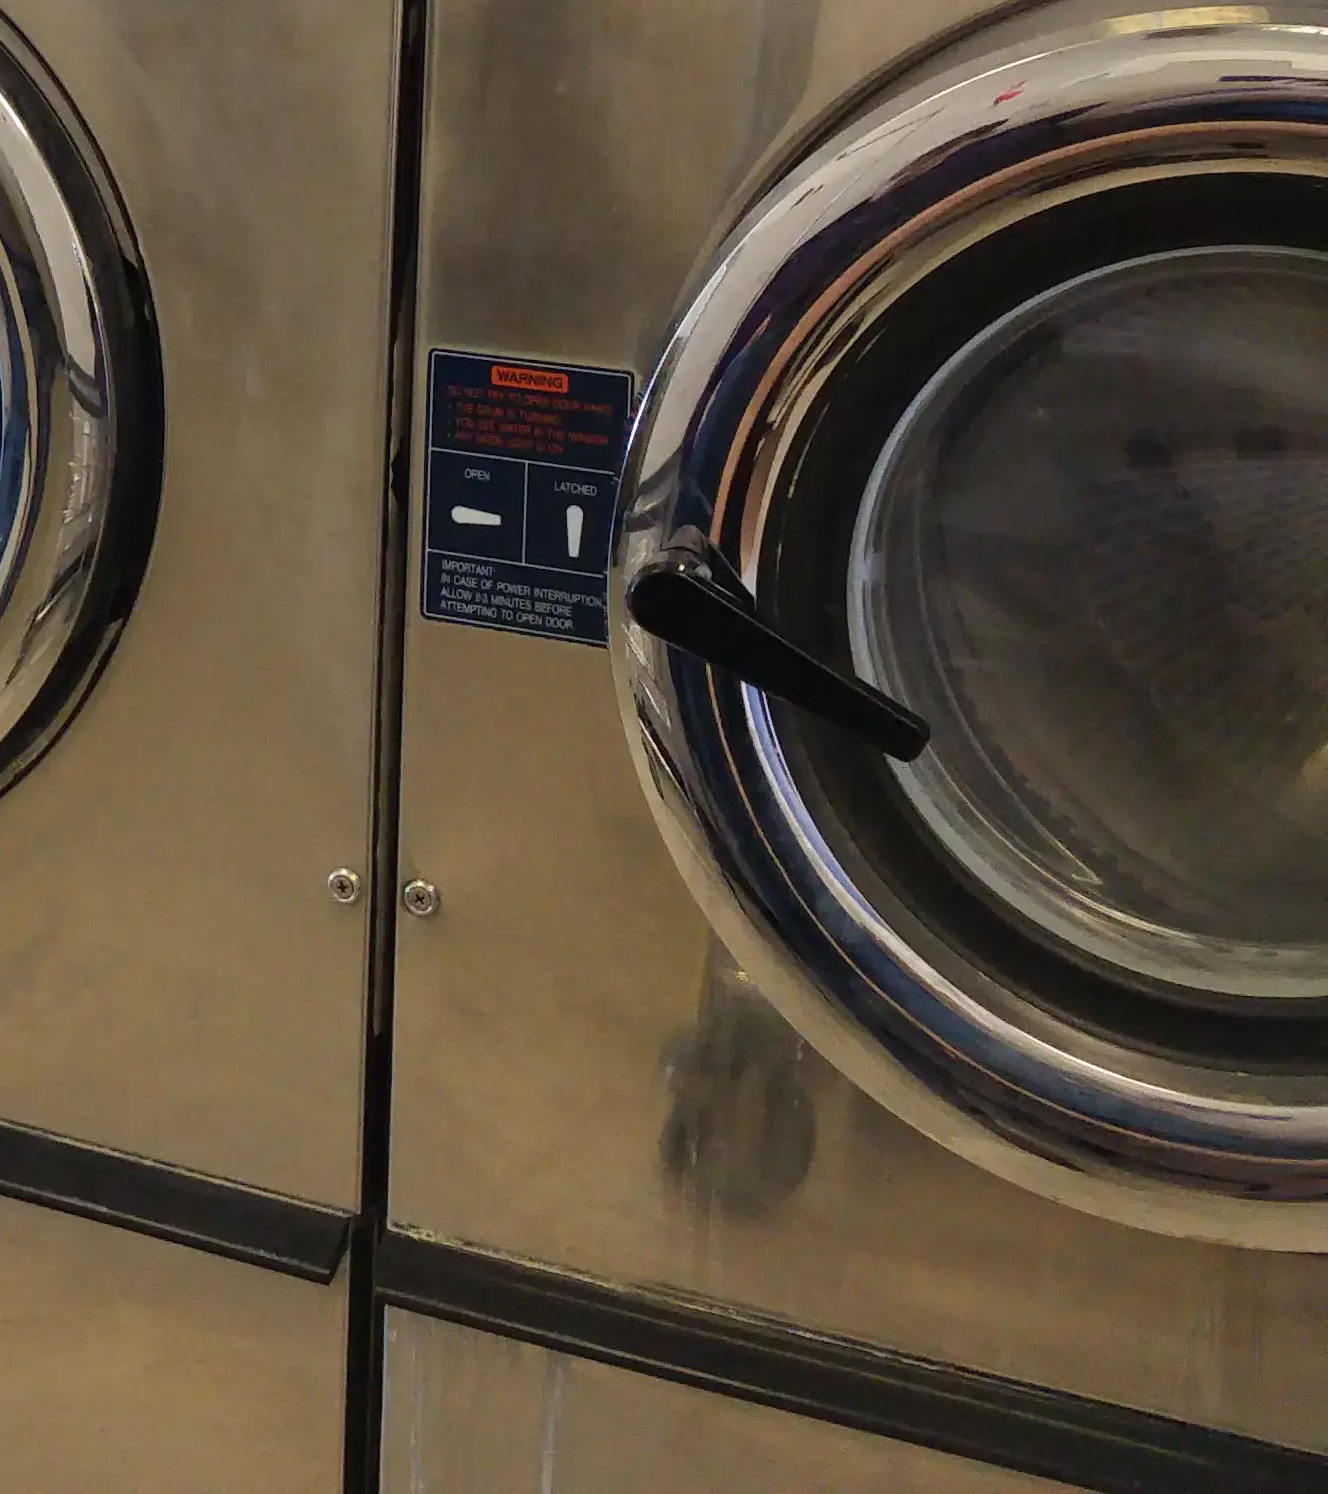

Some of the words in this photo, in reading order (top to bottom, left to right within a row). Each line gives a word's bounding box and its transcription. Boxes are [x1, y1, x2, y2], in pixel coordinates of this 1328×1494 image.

[498, 369, 563, 390] WARNING
[464, 468, 491, 482] OPEN
[553, 481, 598, 497] LATCHED
[441, 573, 451, 584] IN
[453, 575, 478, 588] CASE
[481, 578, 494, 590] OF
[497, 582, 532, 597] POWER
[441, 586, 474, 601] ALLOW
[491, 595, 532, 610] MINUTES
[535, 602, 573, 617] BEFORE
[441, 600, 497, 618] ATTEMPTING
[501, 608, 514, 621] TO
[516, 612, 543, 626] OPEN
[545, 616, 573, 630] DOOR
